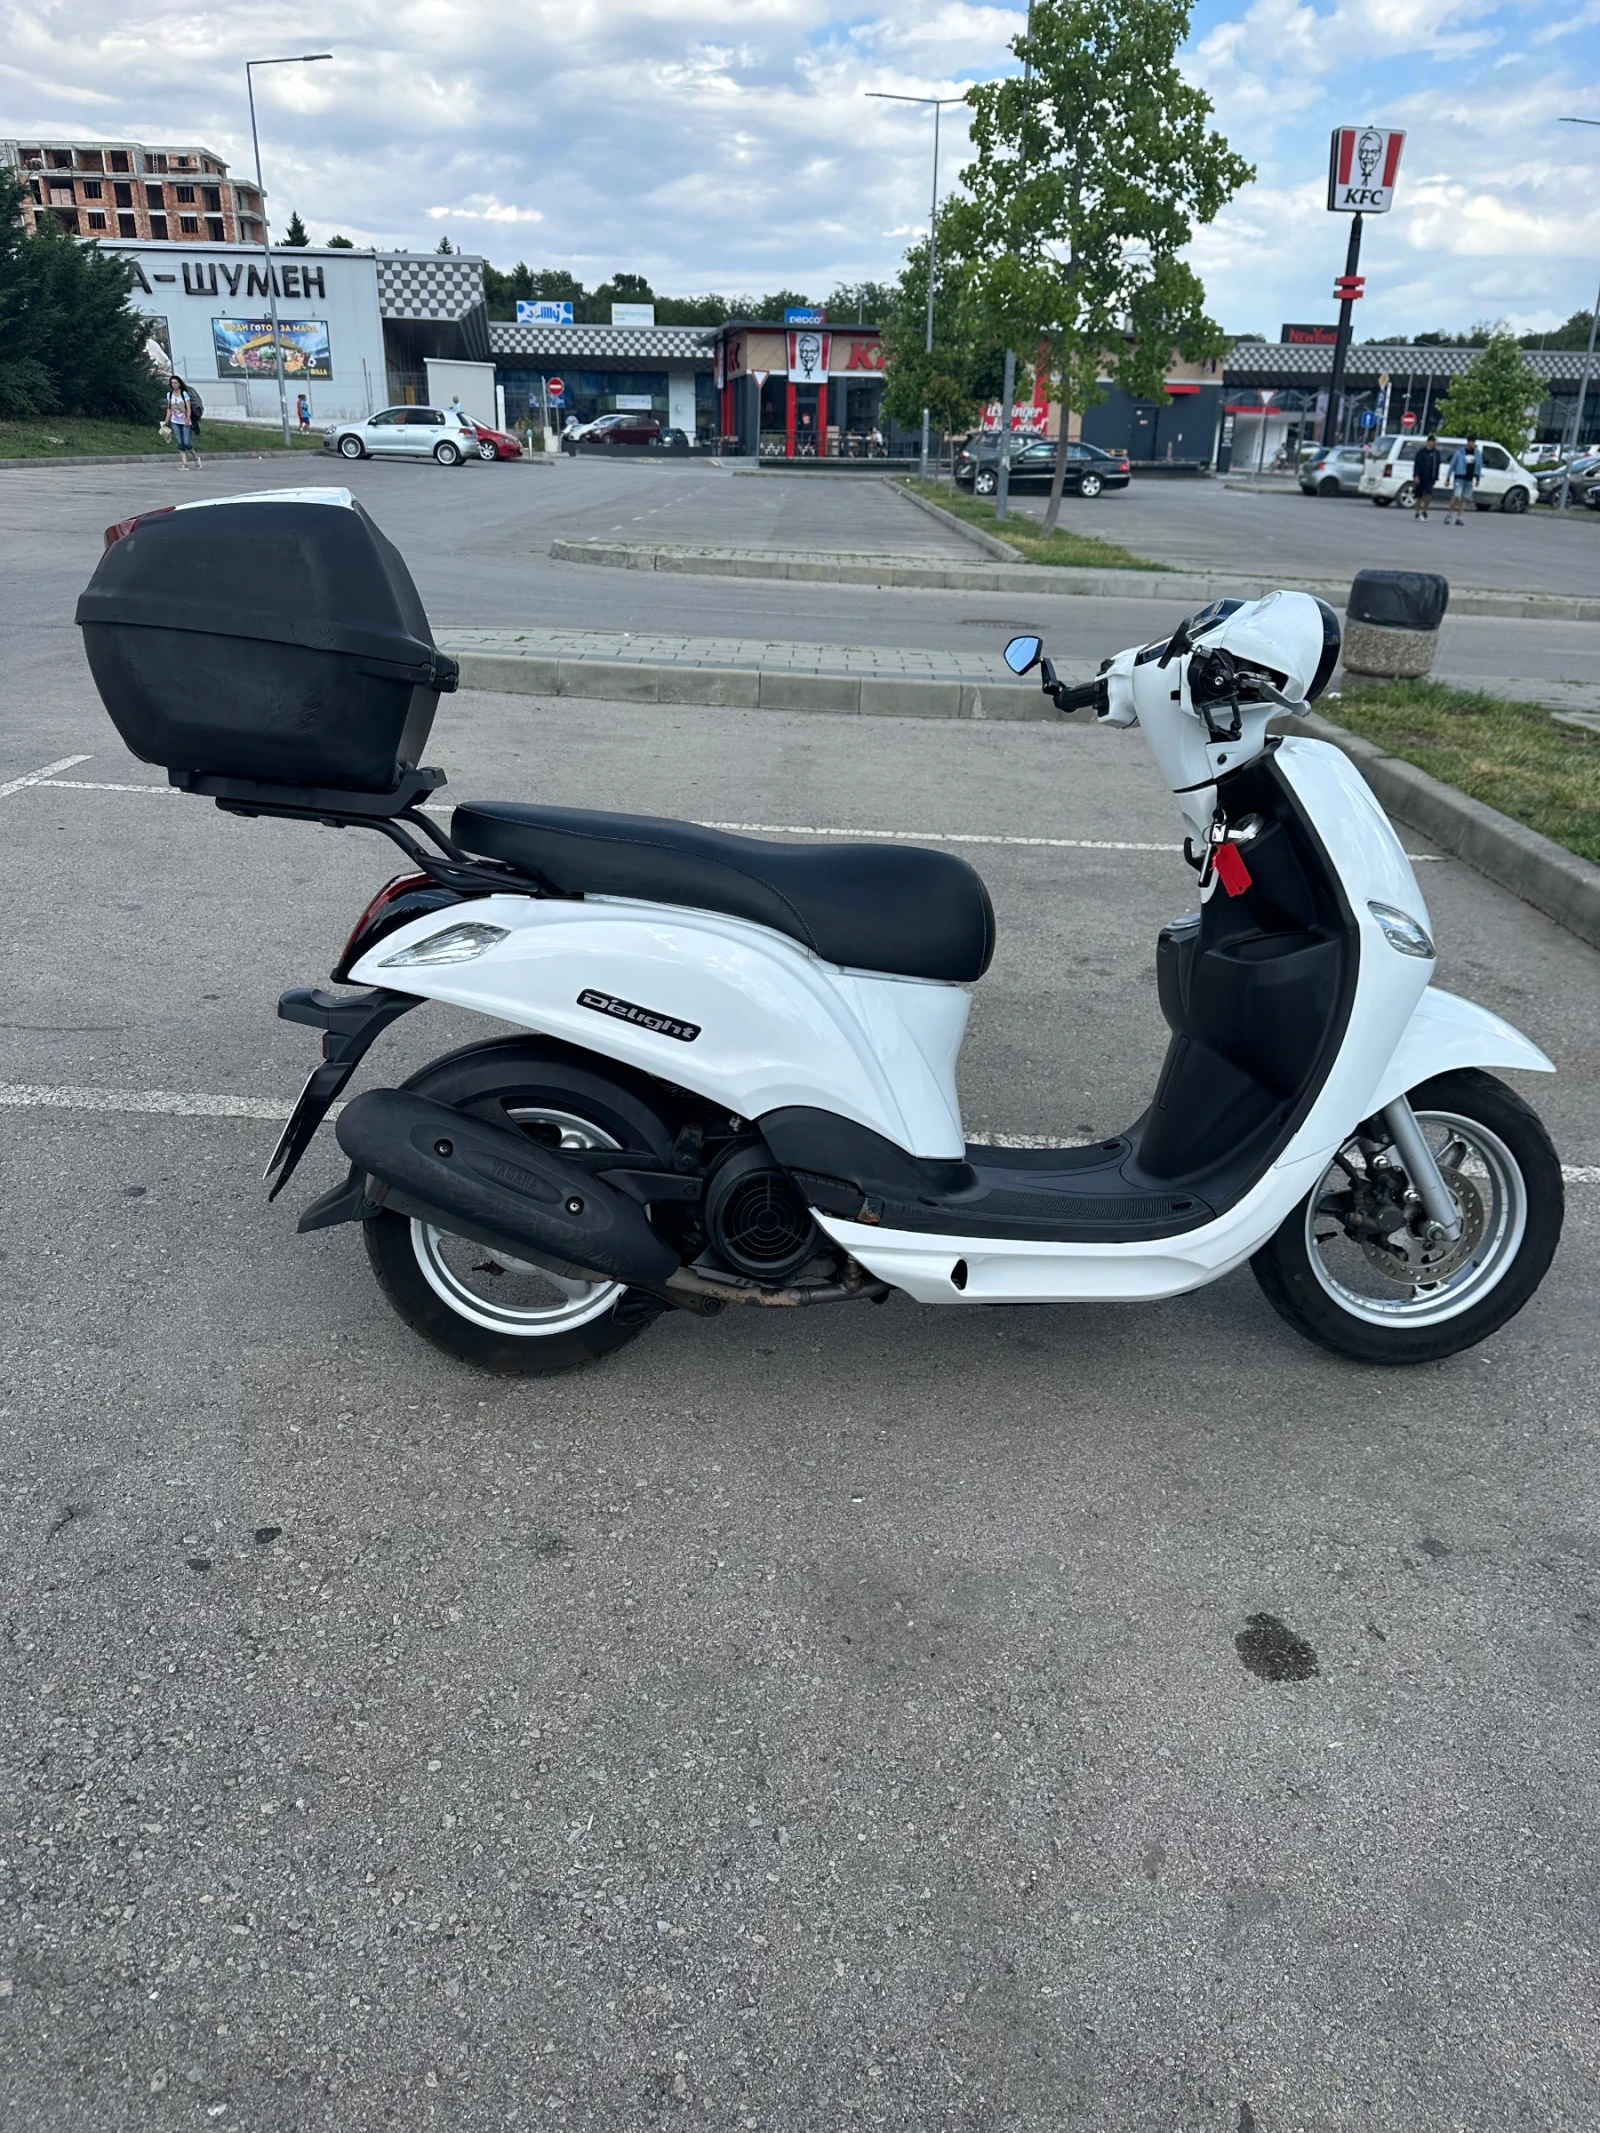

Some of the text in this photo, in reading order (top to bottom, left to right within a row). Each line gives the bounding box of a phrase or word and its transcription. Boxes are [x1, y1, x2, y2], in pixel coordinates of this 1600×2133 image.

[1343, 188, 1384, 205] KFC
[280, 325, 291, 333] ЗА
[310, 368, 328, 376] BILLA
[492, 1160, 539, 1192] YAMAHA
